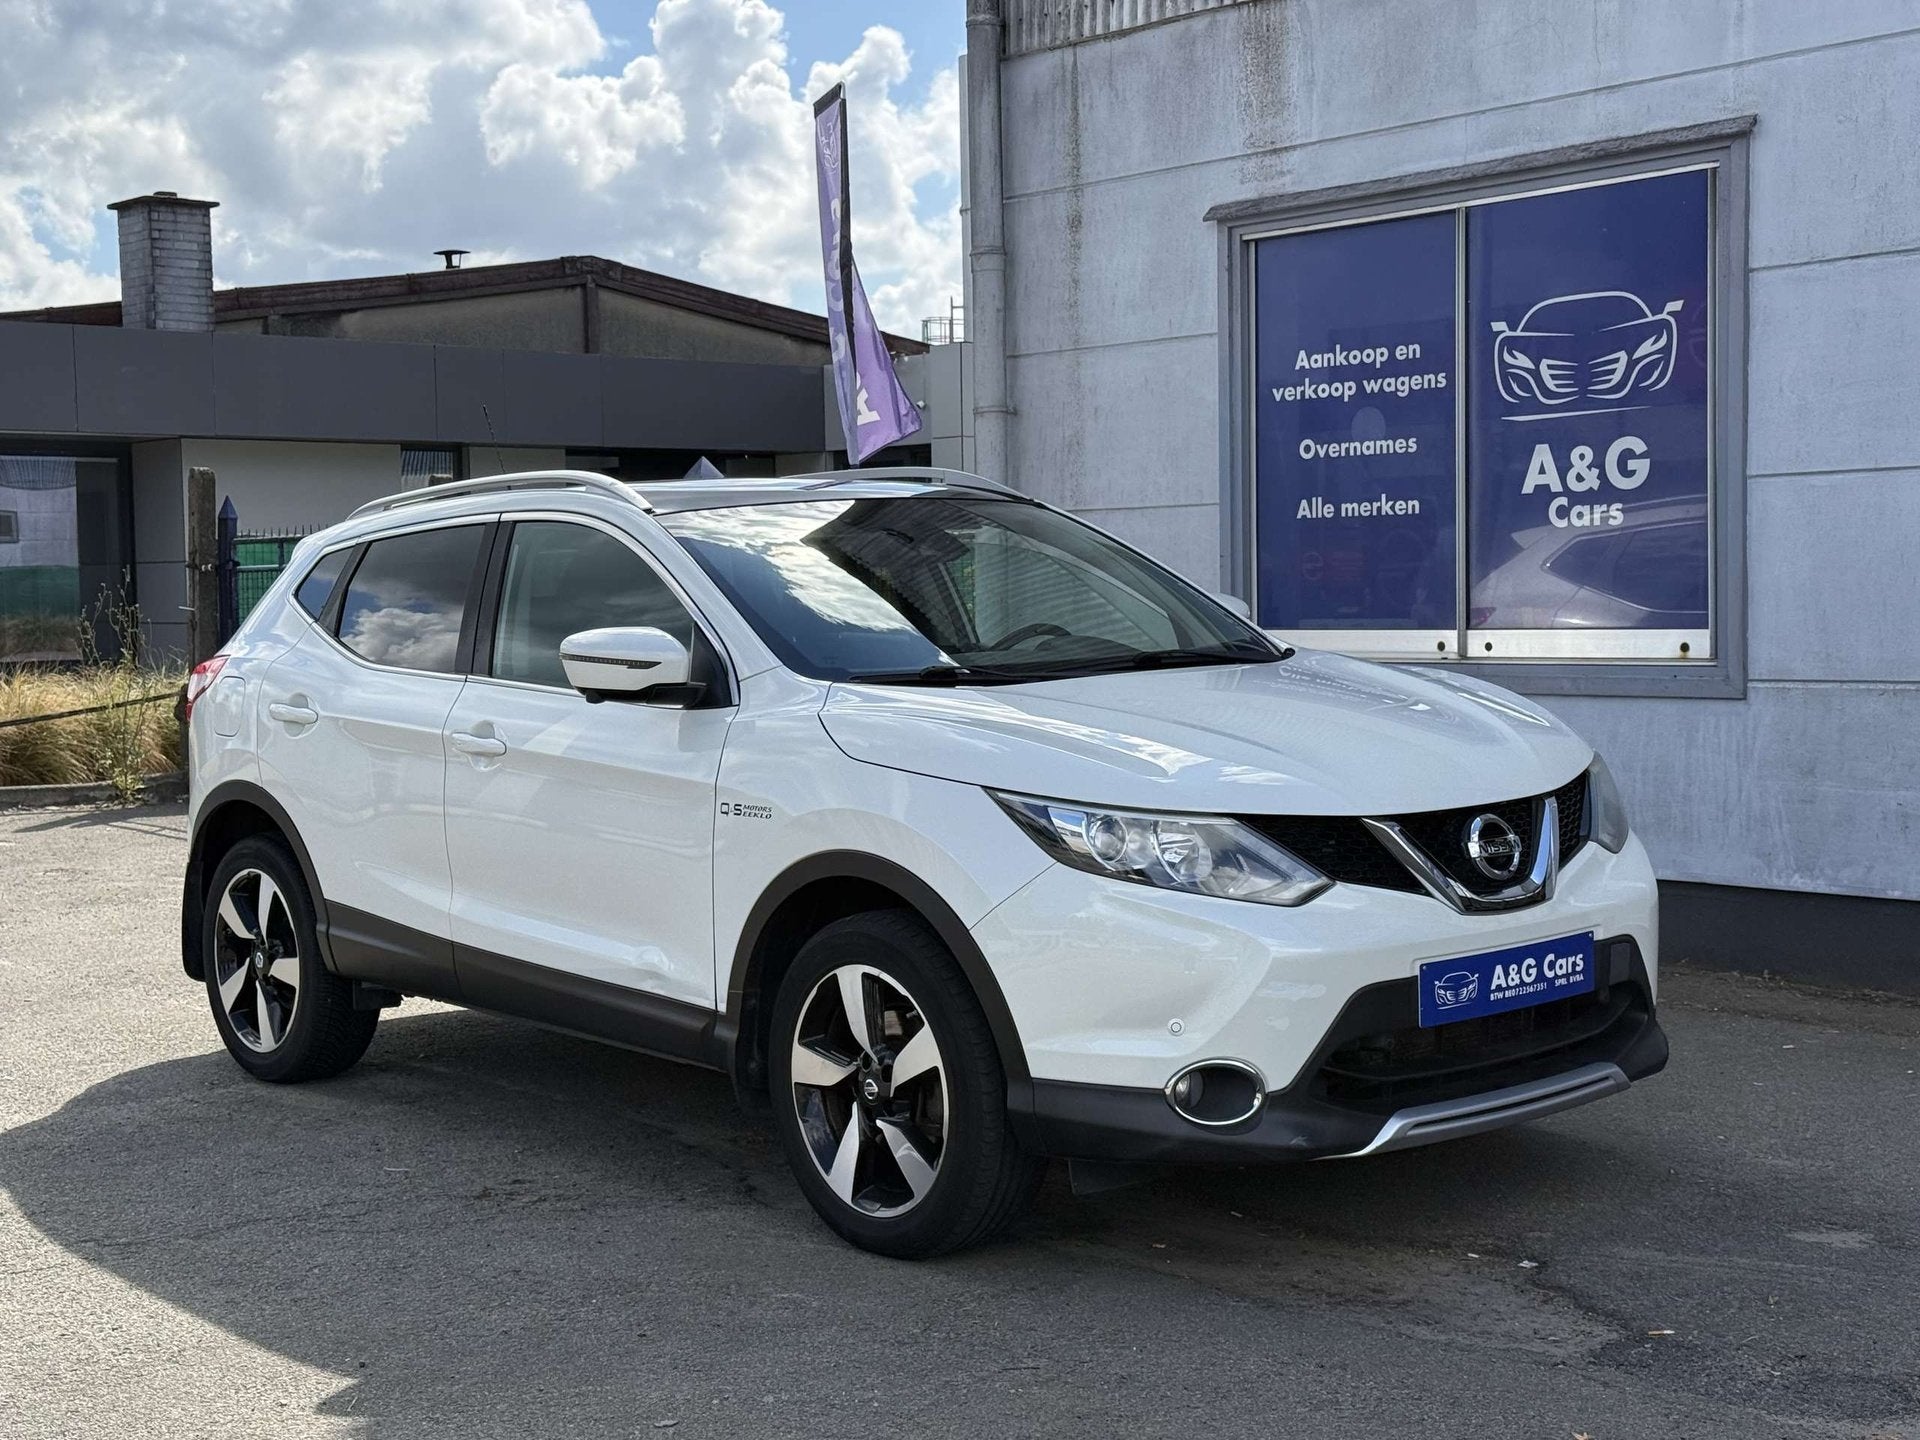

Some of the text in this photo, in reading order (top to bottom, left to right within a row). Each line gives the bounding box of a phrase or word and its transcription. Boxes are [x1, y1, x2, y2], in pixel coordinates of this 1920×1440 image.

[1295, 343, 1421, 370] Aankoop en
[1272, 372, 1447, 402] verkoop wagens
[1299, 437, 1418, 460] Overnames
[1521, 435, 1651, 494] A&G
[1296, 493, 1420, 519] Alle merken
[1548, 496, 1625, 528] Cars
[1490, 953, 1584, 990] A&G Cars
[1490, 990, 1504, 1001] BTW
